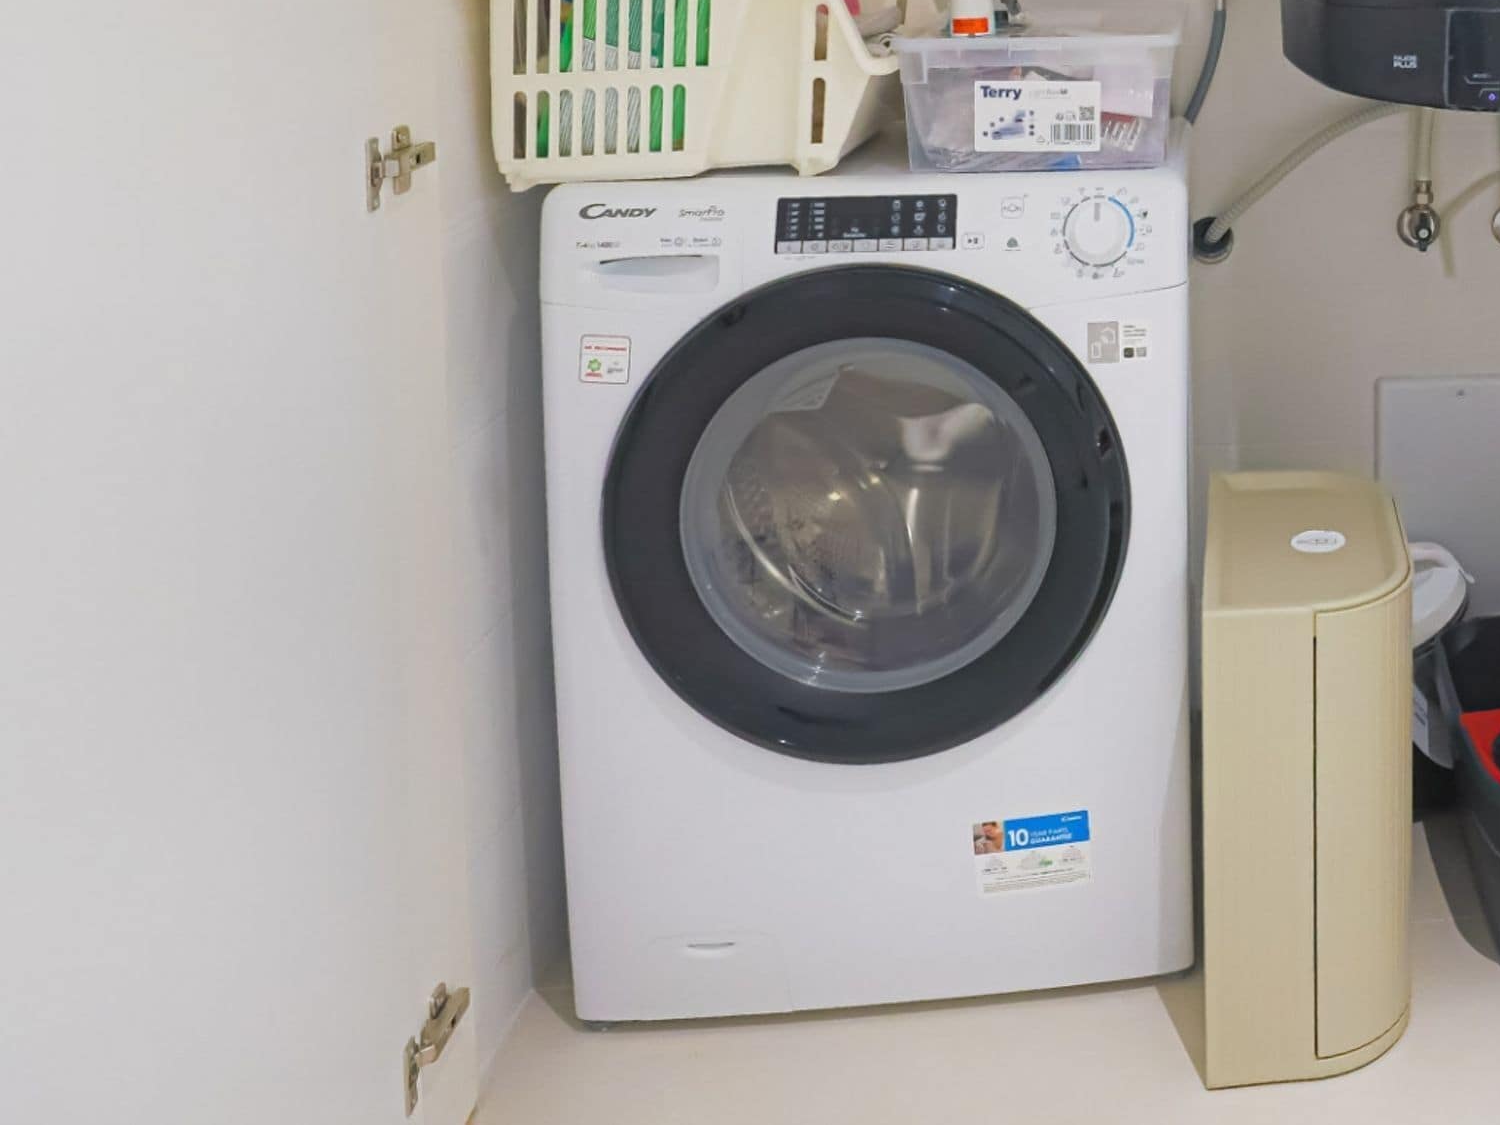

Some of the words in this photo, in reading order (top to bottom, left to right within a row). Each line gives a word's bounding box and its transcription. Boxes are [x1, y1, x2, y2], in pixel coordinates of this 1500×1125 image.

[1393, 60, 1417, 68] PLUS
[981, 85, 1022, 101] Terry
[579, 203, 656, 219] CANDY
[1008, 828, 1029, 847] 10
